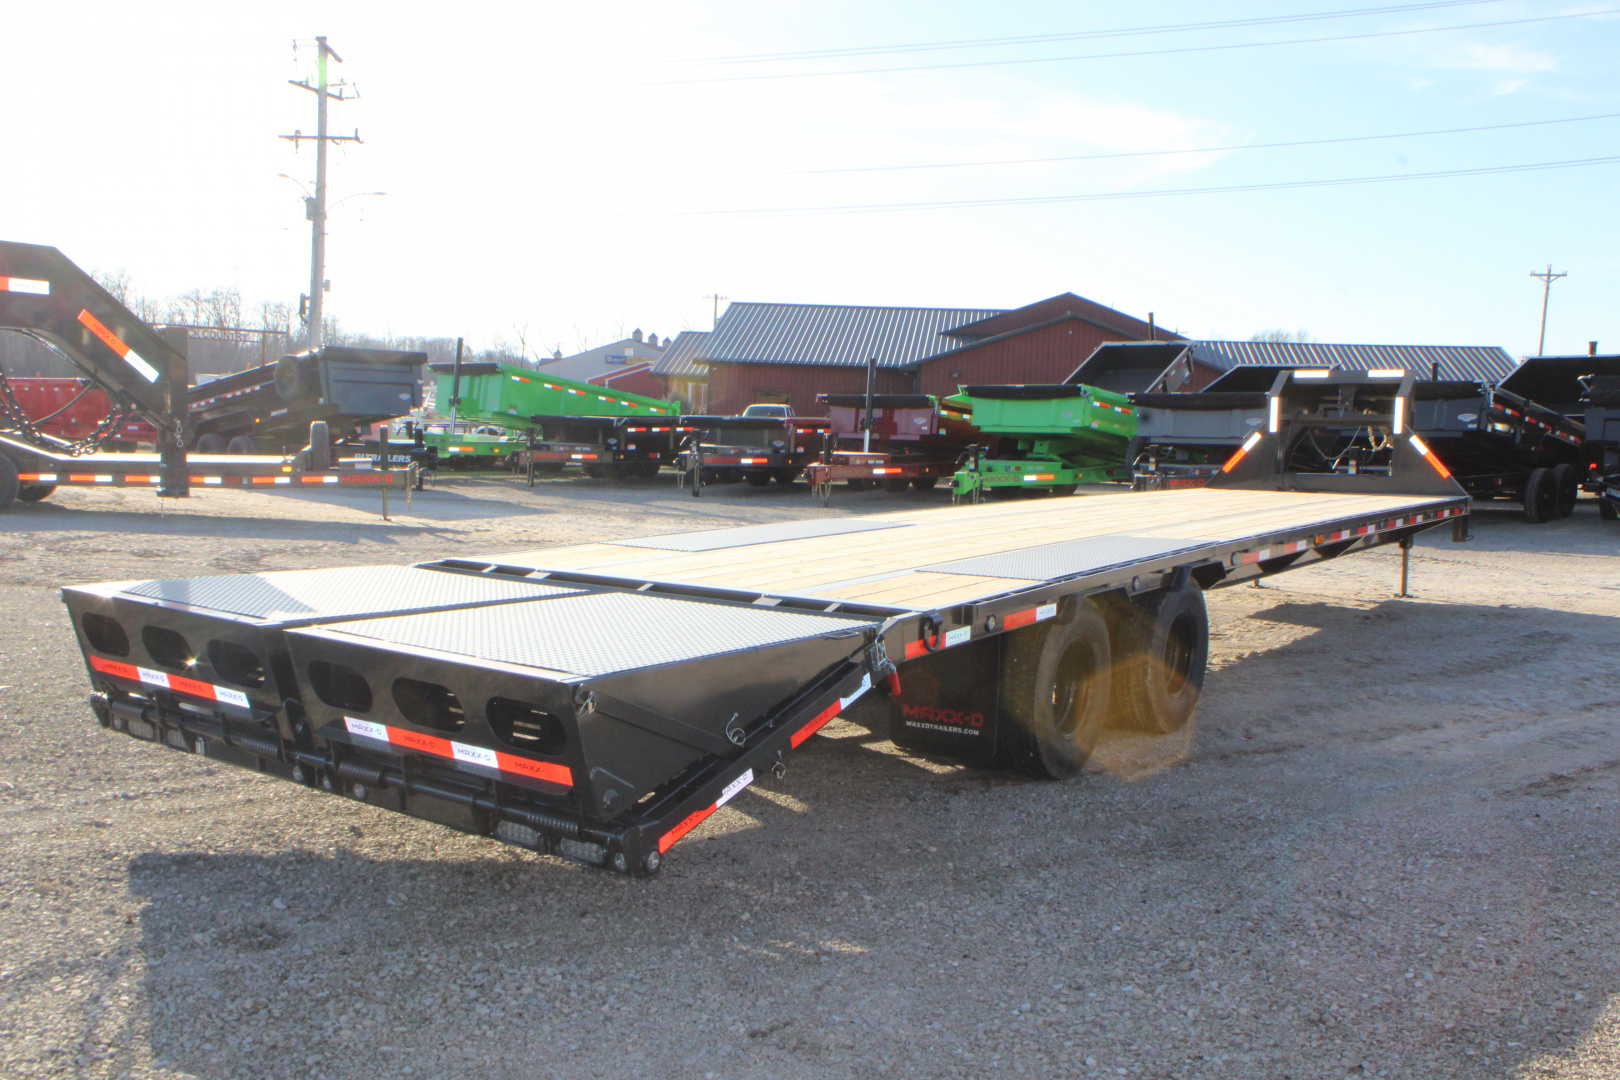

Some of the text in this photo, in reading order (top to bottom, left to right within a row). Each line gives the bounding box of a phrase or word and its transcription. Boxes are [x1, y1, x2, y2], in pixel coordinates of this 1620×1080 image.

[202, 330, 249, 341] COUNTRY
[340, 473, 394, 484] MAXX-D
[983, 475, 1020, 483] MAXX-D
[142, 671, 165, 682] MAXX-D
[220, 690, 244, 702] MAXX-D
[903, 704, 984, 728] MAXX-D
[905, 720, 980, 736] MAXXDTRAILERS.COM
[351, 722, 382, 736] MAXX-D
[403, 734, 435, 749] MAXX-D
[457, 747, 491, 762] MAXX-D
